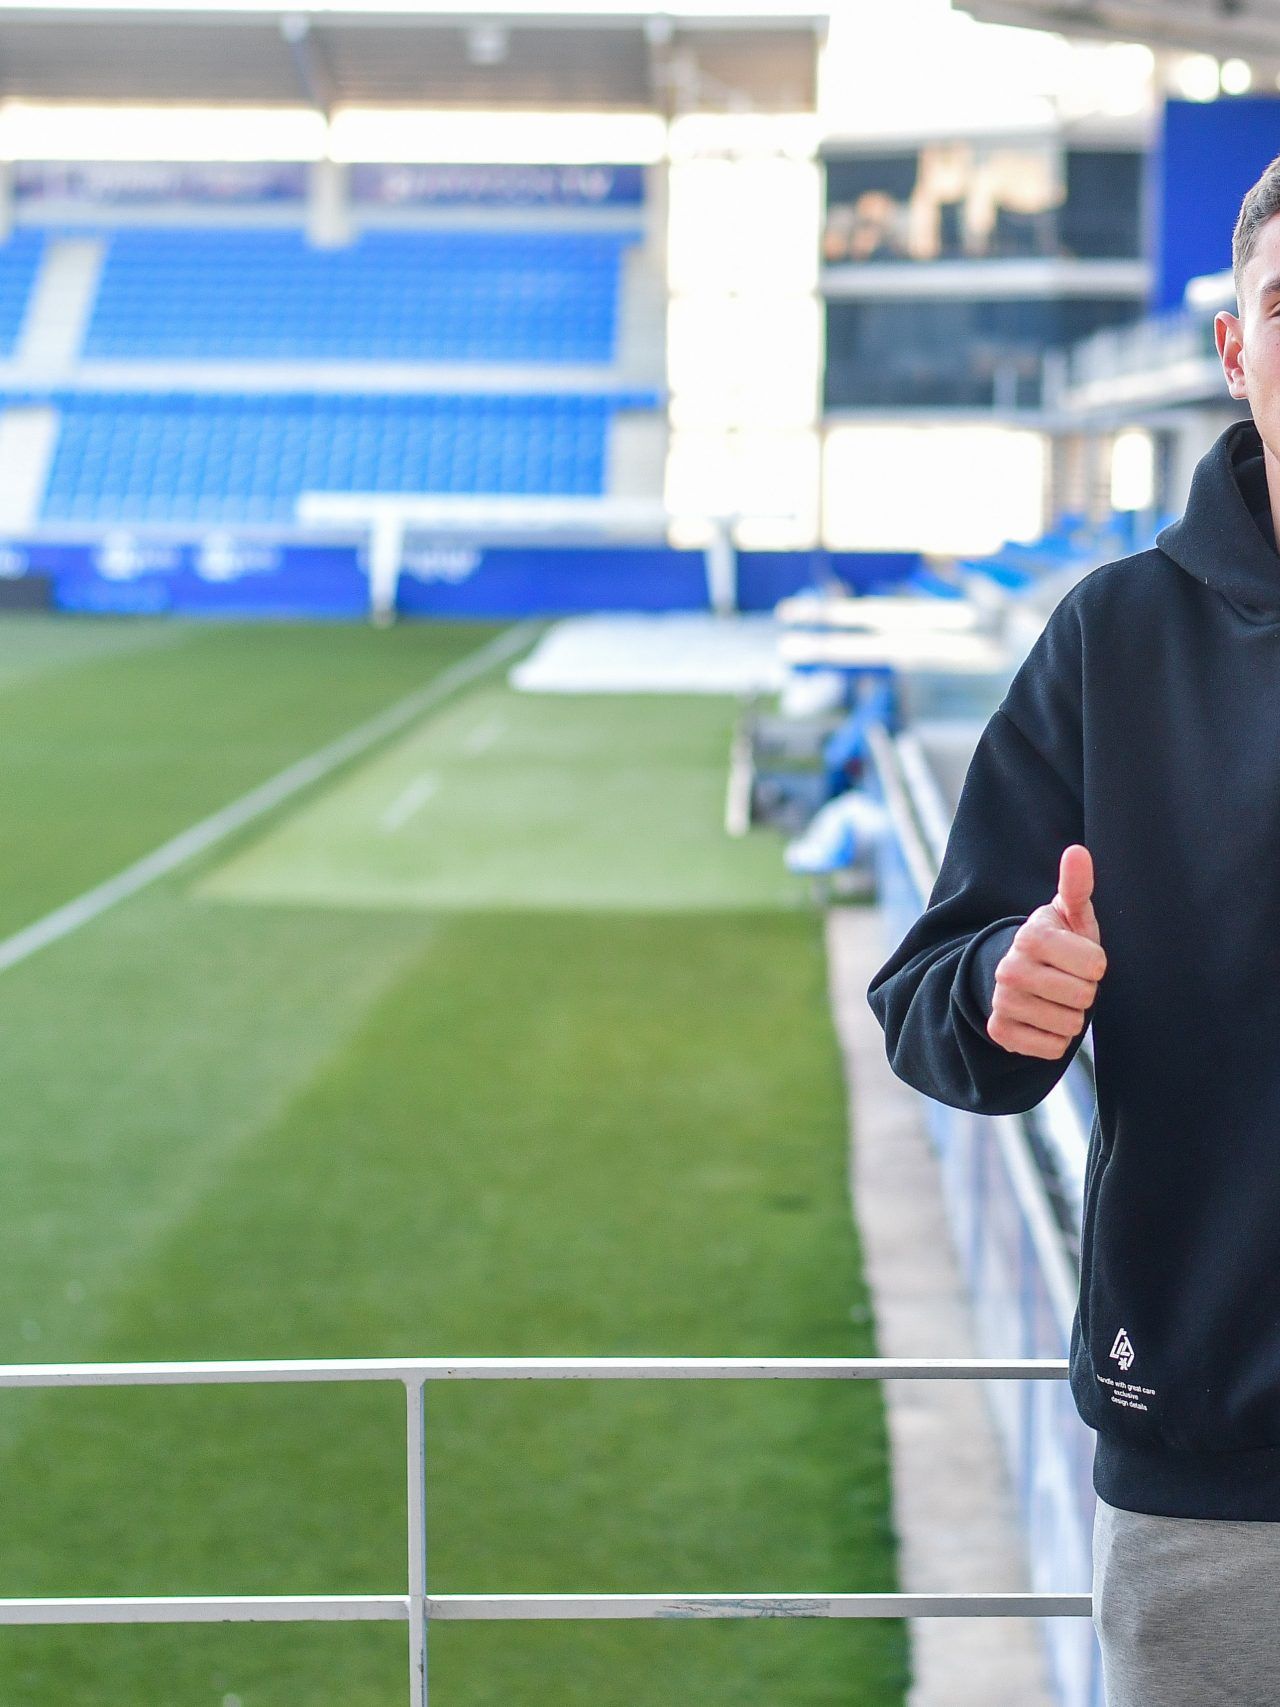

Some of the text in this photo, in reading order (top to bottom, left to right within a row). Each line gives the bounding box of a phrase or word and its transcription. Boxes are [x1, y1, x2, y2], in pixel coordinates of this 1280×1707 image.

[1114, 1389, 1138, 1400] exclusive
[1115, 1380, 1126, 1389] with
[1128, 1384, 1142, 1392] great
[1142, 1387, 1156, 1396] care
[1111, 1396, 1148, 1411] design details
